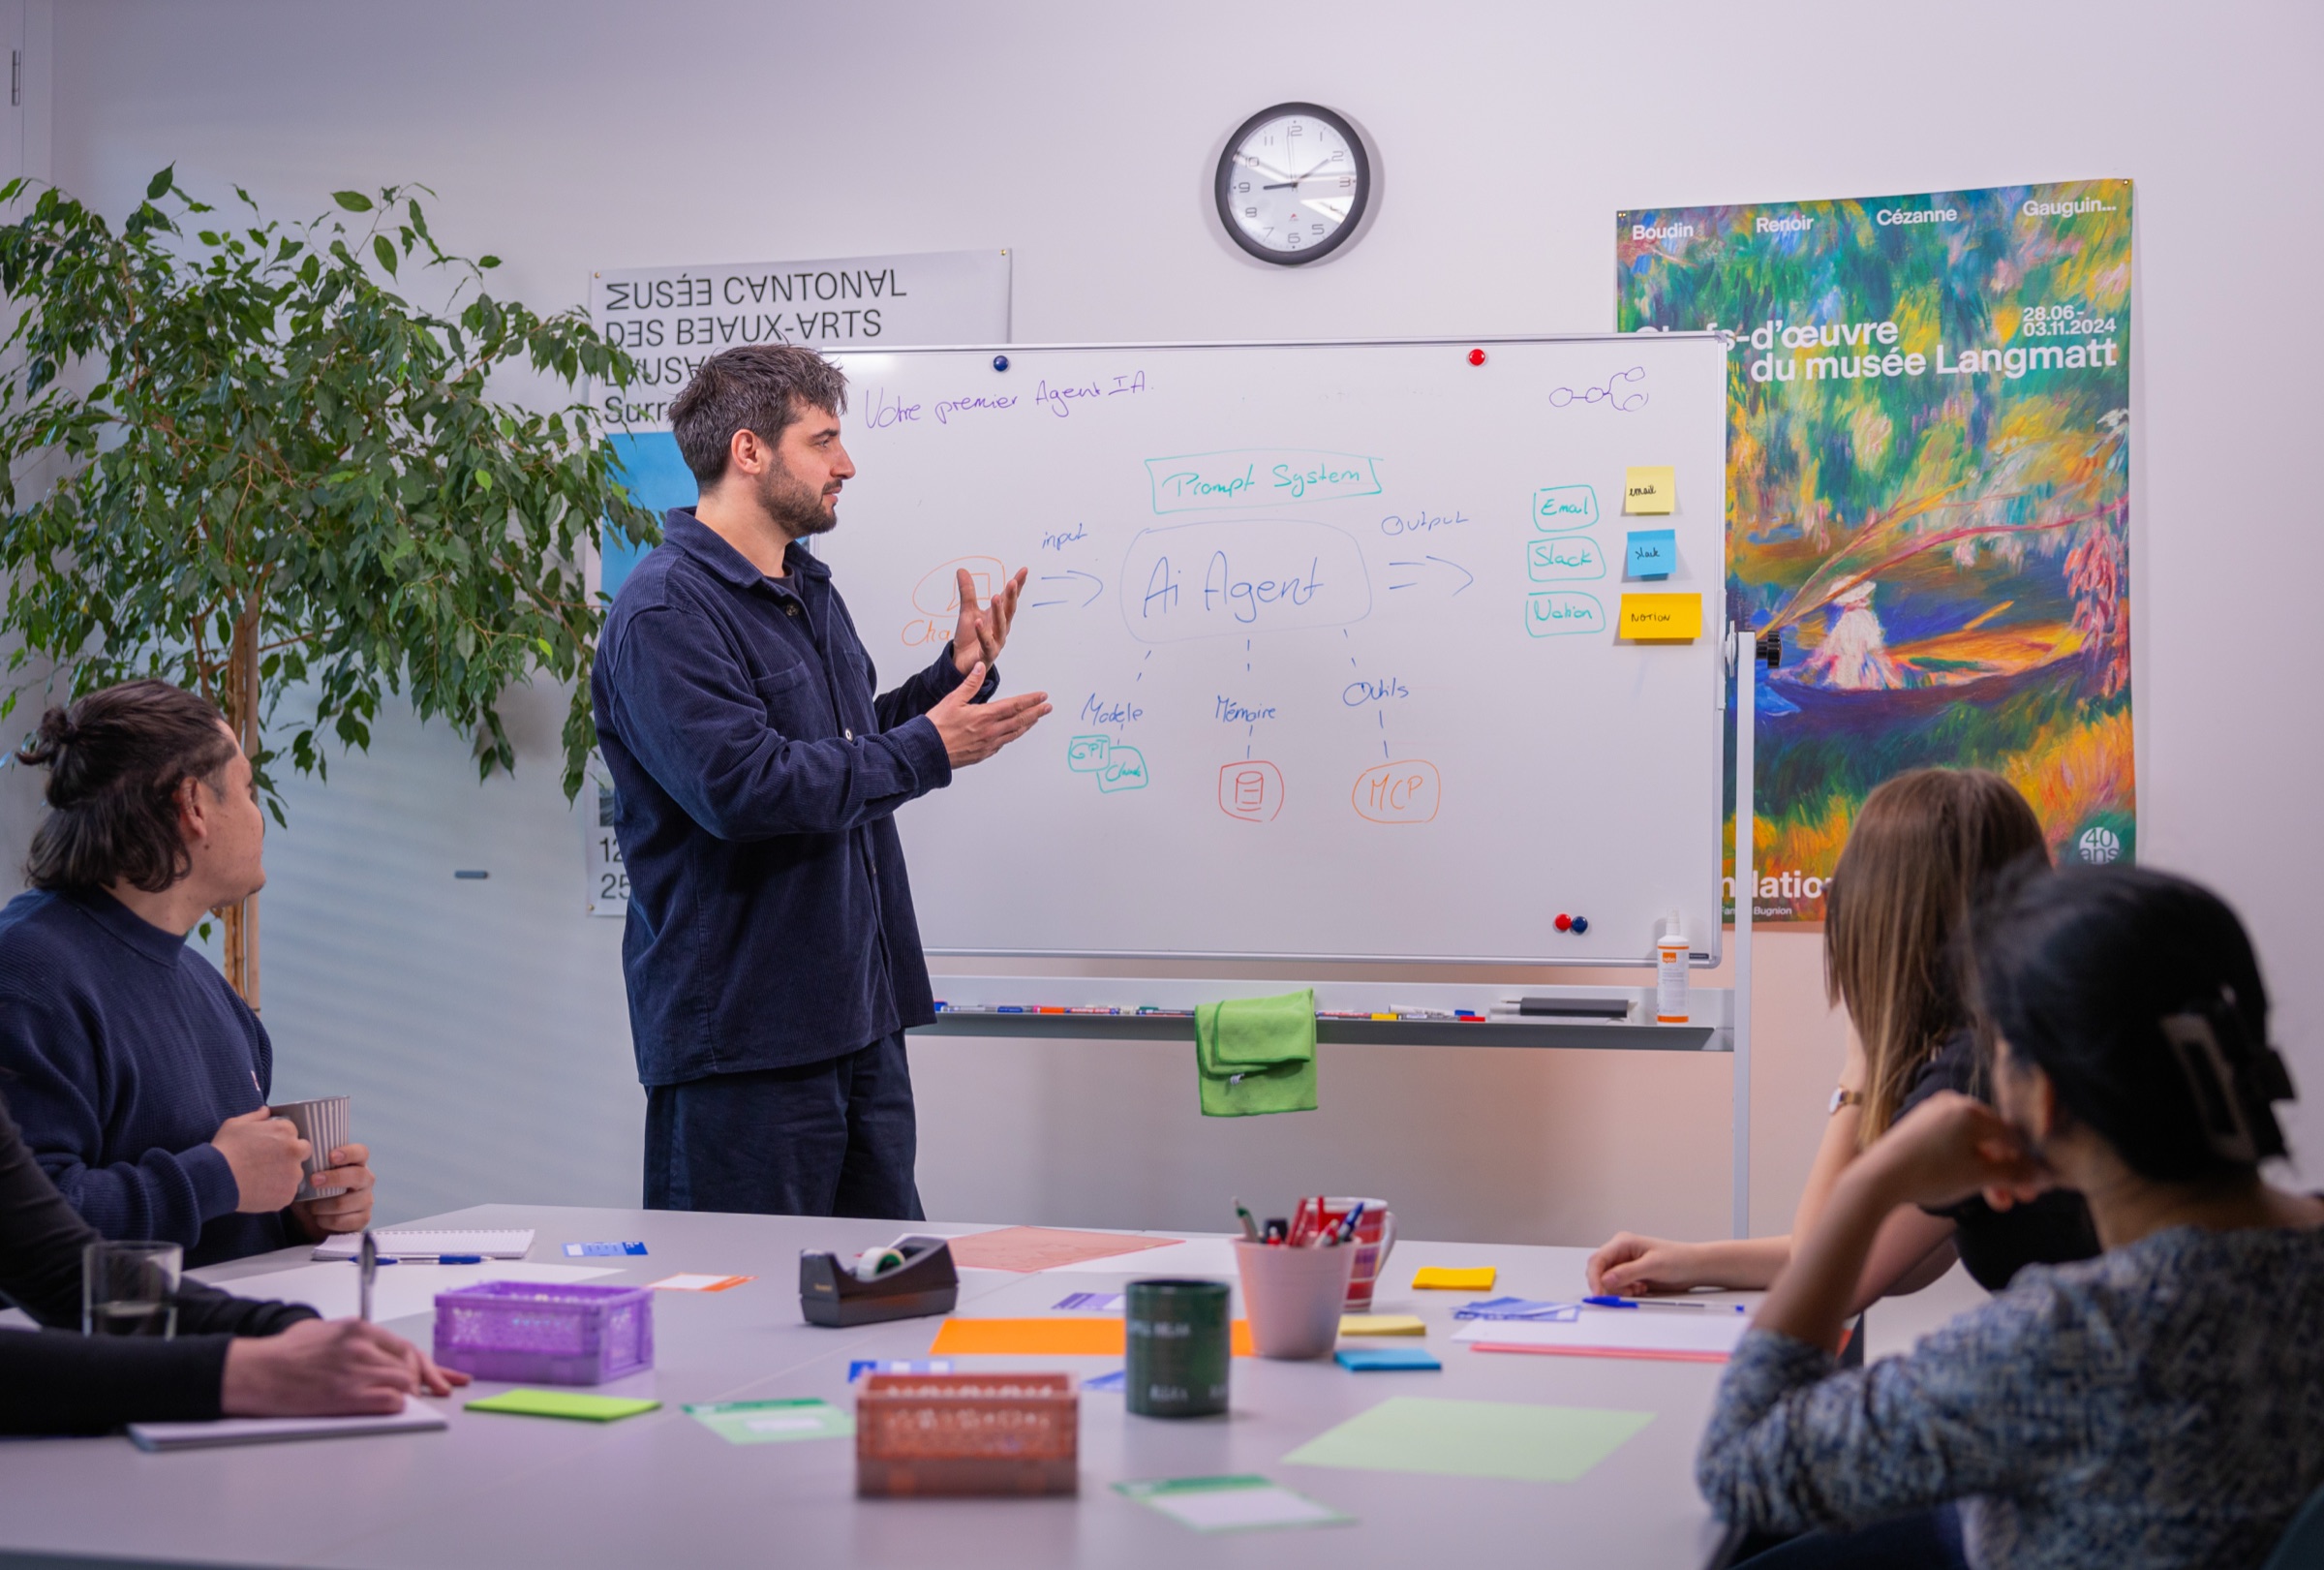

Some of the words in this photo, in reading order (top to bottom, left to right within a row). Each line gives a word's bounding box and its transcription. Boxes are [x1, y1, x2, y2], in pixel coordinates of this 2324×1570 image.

[1286, 125, 1302, 138] 12
[1331, 150, 1344, 162] 2
[1238, 181, 1251, 194] 9
[1339, 176, 1352, 188] 3
[1245, 206, 1258, 219] 8
[1632, 223, 1694, 241] Boudin
[1755, 214, 1815, 233] Renoir
[1876, 205, 1958, 226] Cézanne
[2022, 199, 2118, 221] Gauguin...
[1287, 232, 1301, 244] 6
[1311, 223, 1326, 235] 5
[606, 273, 713, 311] MUSÉE
[723, 268, 907, 305] CANTONAL
[605, 319, 664, 348] DES
[677, 309, 882, 345] BEAUX-ARTS
[2023, 317, 2117, 337] 03.11.2024
[1750, 354, 1797, 383] du
[1805, 347, 1927, 380] musée
[1936, 336, 2118, 379] Langmatt
[604, 395, 677, 423] Surr
[866, 387, 921, 428] Votre
[934, 393, 1018, 424] premier
[1035, 380, 1101, 417] Agent
[1161, 463, 1255, 498] Prompt
[1271, 462, 1360, 498] System
[1540, 496, 1588, 516] Email
[1042, 522, 1087, 551] input
[1534, 542, 1592, 567] Slack
[1204, 550, 1324, 624] Agent
[1534, 599, 1593, 622] Notion
[902, 620, 950, 647] Cha
[1342, 677, 1410, 707] Outils
[1215, 694, 1276, 723] Mémoire
[1069, 738, 1108, 759] GPT
[1370, 773, 1423, 811] MCP
[2085, 826, 2113, 847] 40
[2079, 847, 2120, 863] ans
[1722, 870, 1833, 899] natio
[1753, 906, 1793, 917] Bugnion
